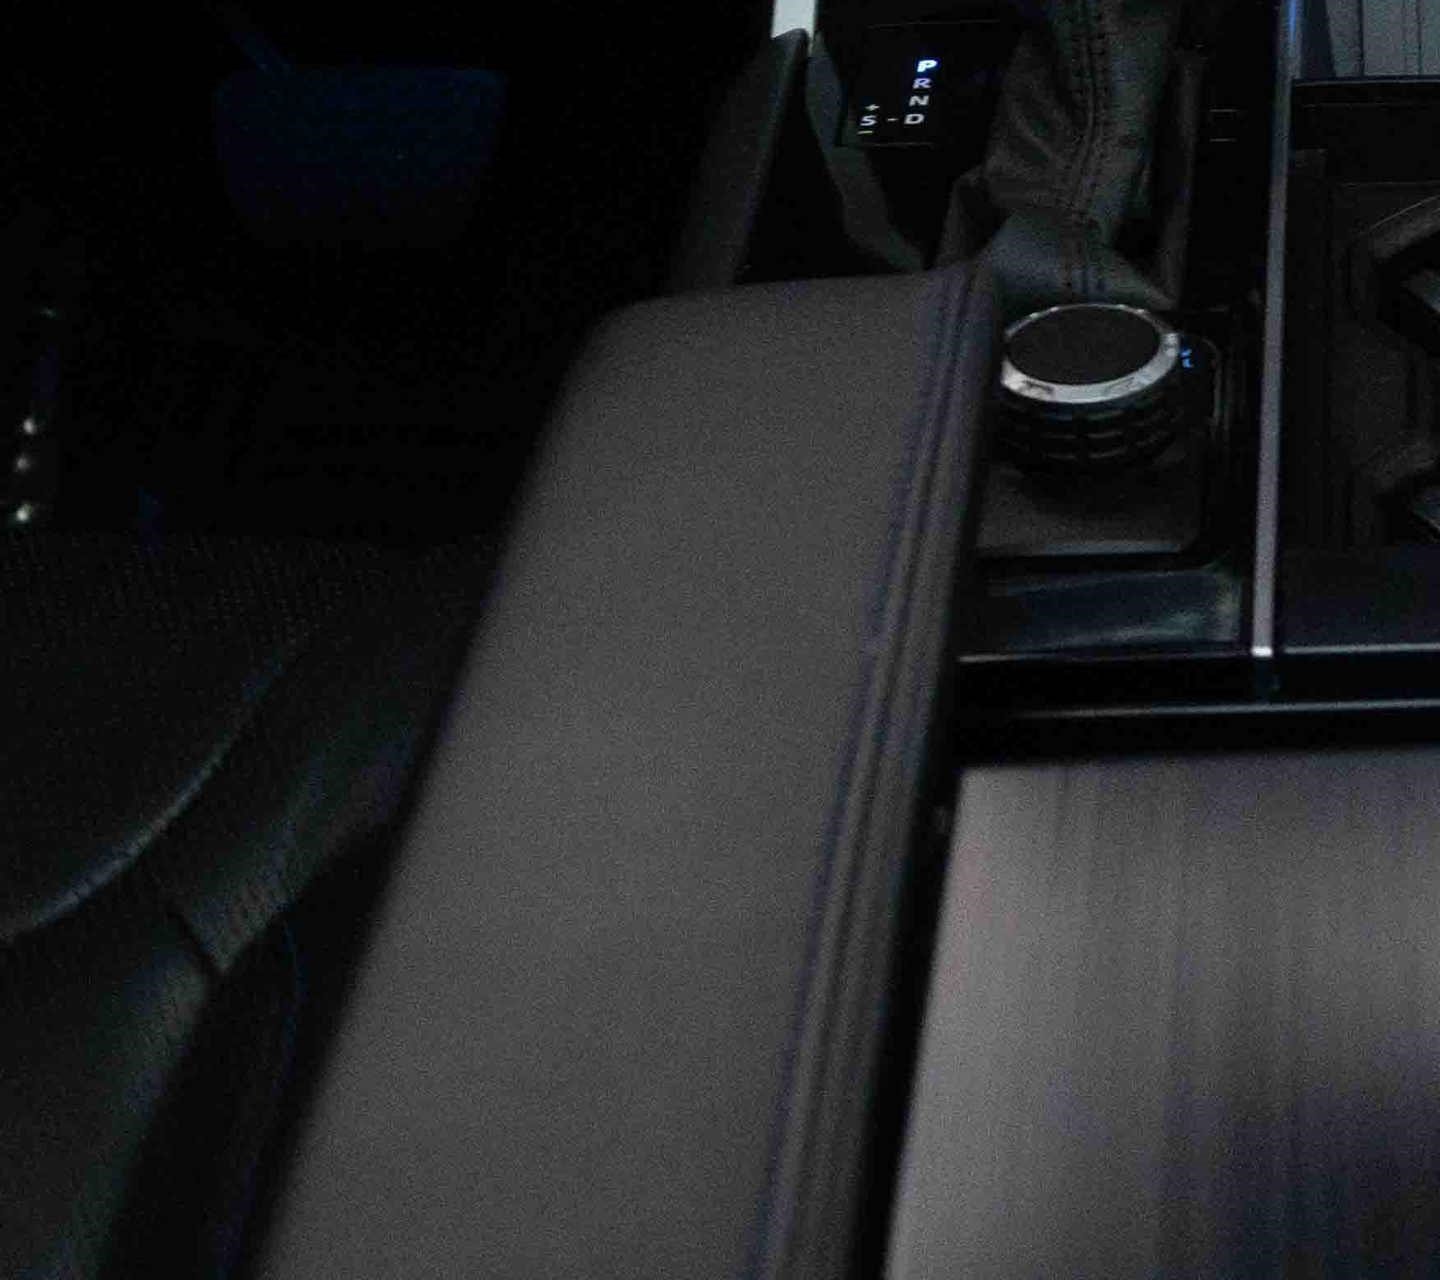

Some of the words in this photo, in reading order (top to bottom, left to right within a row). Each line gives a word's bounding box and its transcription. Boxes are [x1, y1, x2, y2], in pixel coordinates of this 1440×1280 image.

[917, 59, 938, 72] P
[913, 78, 931, 89] R
[909, 96, 929, 106] N
[904, 114, 925, 124] D
